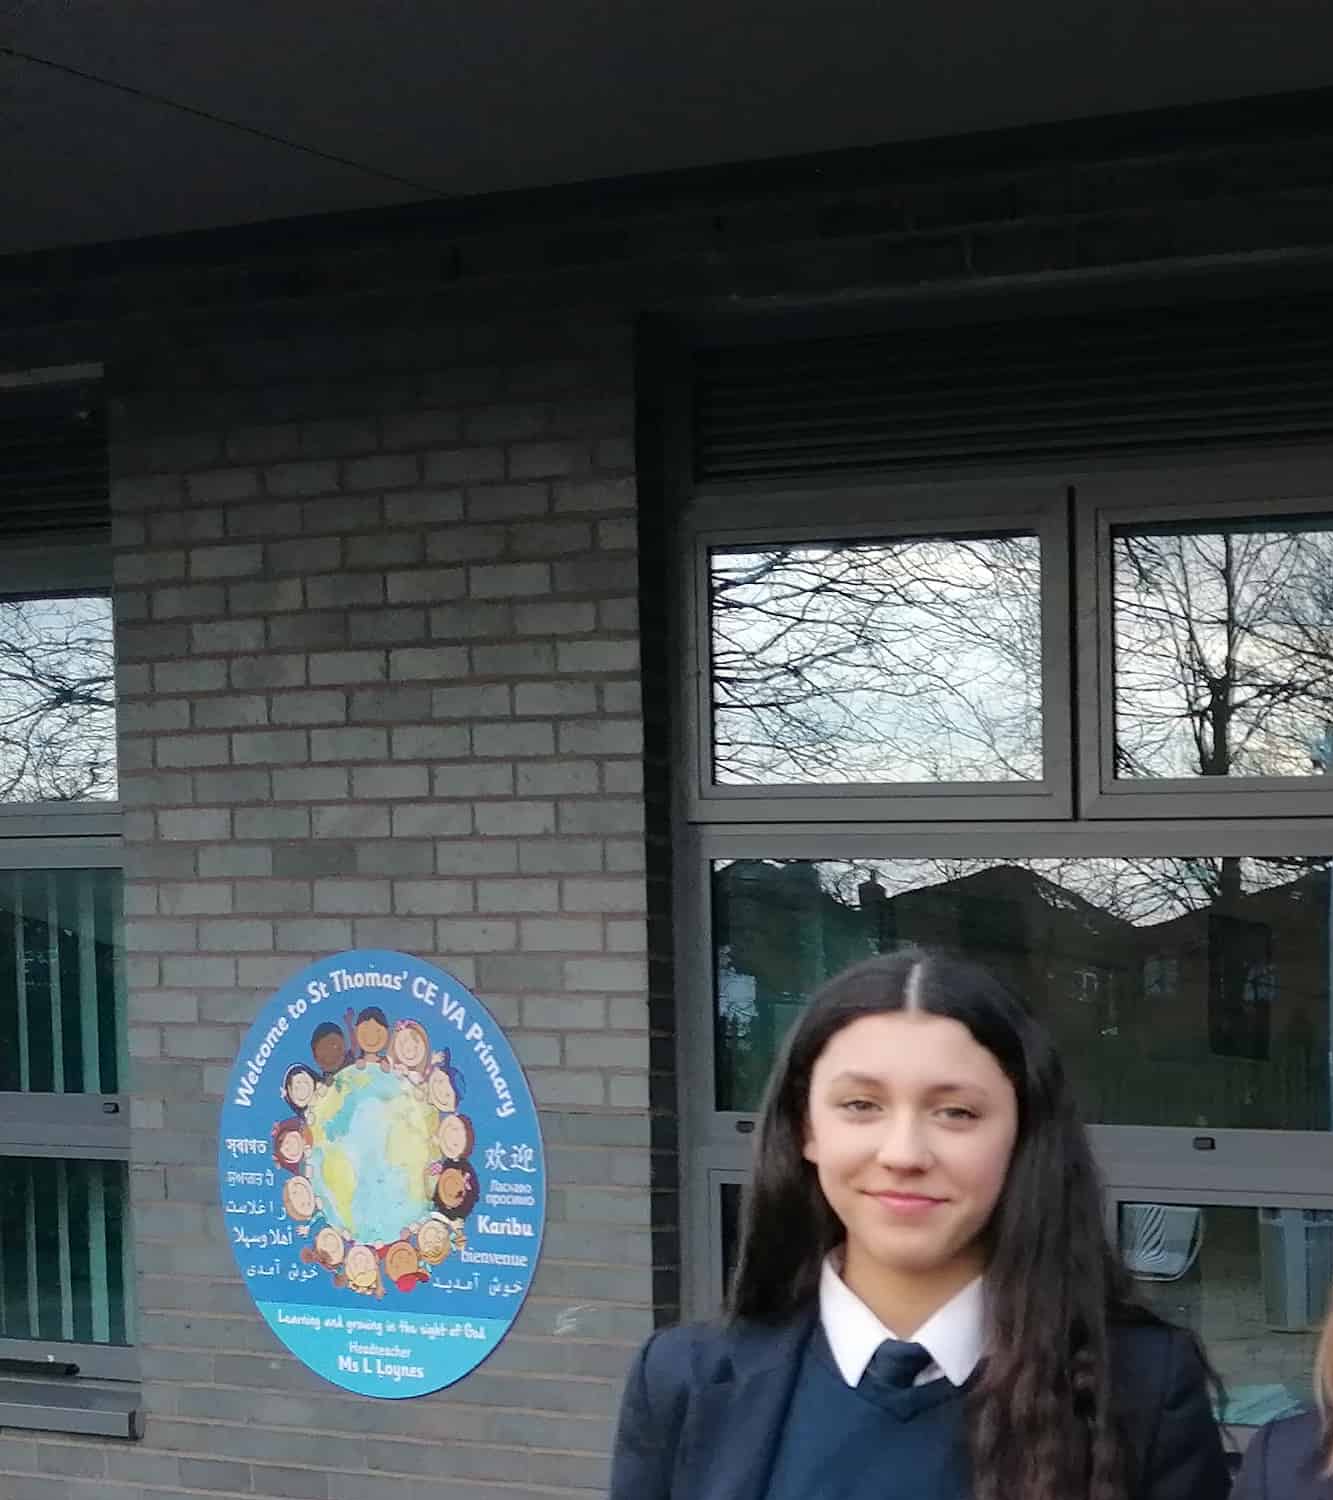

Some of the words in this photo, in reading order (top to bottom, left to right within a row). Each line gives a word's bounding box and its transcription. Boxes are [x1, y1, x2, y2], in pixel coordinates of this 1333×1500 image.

[235, 1014, 290, 1107] Welcome
[289, 998, 308, 1019] to
[306, 980, 330, 1005] St
[412, 977, 439, 1006] CE
[441, 994, 466, 1030] VA
[465, 1022, 517, 1119] Primary
[486, 1141, 537, 1172] 欢迎
[478, 1215, 535, 1237] Karibu
[278, 1309, 321, 1330] Learning
[324, 1313, 345, 1328] and
[347, 1319, 384, 1335] growing
[386, 1321, 397, 1332] in
[399, 1320, 418, 1335] the
[465, 1322, 486, 1340] God
[348, 1341, 412, 1358] Headteacher
[338, 1355, 359, 1373] Ms
[364, 1357, 373, 1373] L
[377, 1358, 425, 1381] Loynes
